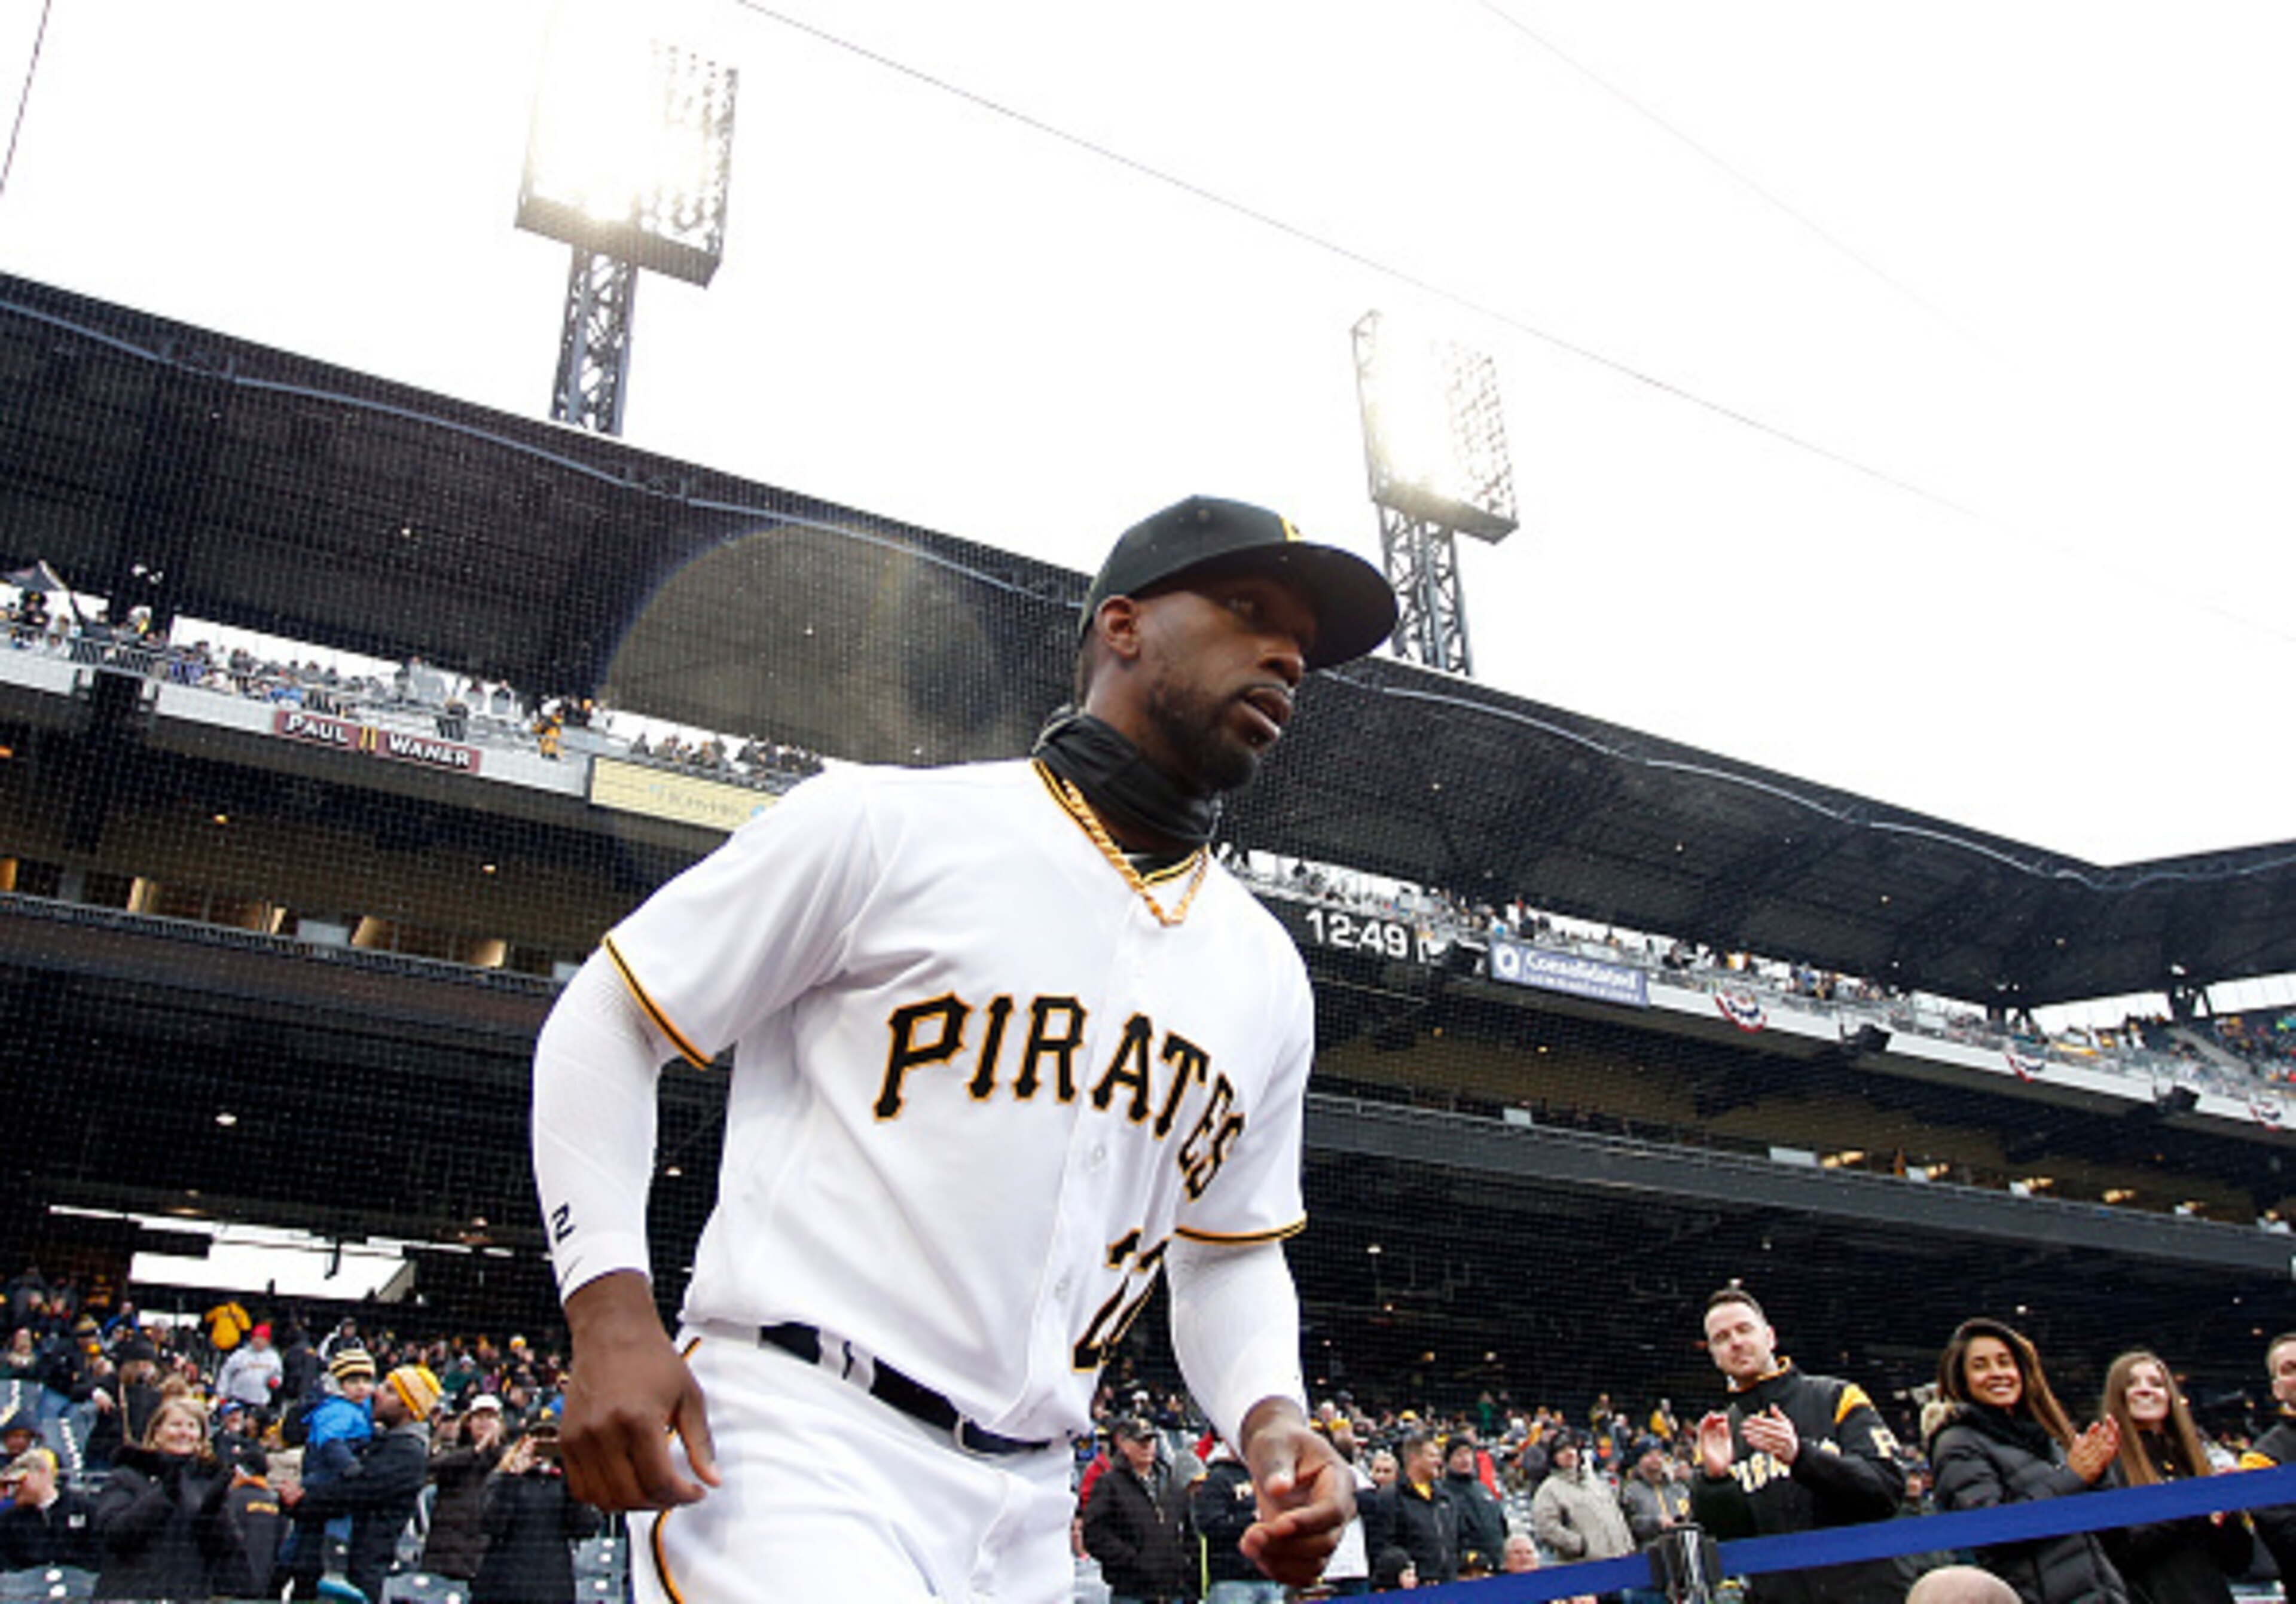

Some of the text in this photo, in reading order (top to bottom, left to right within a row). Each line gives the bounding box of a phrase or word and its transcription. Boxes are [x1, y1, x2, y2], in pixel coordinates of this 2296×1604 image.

[285, 713, 349, 744] PAUL
[388, 732, 471, 767] WANER
[1305, 908, 1407, 958] 12:49
[873, 990, 1245, 1204] PIRATES
